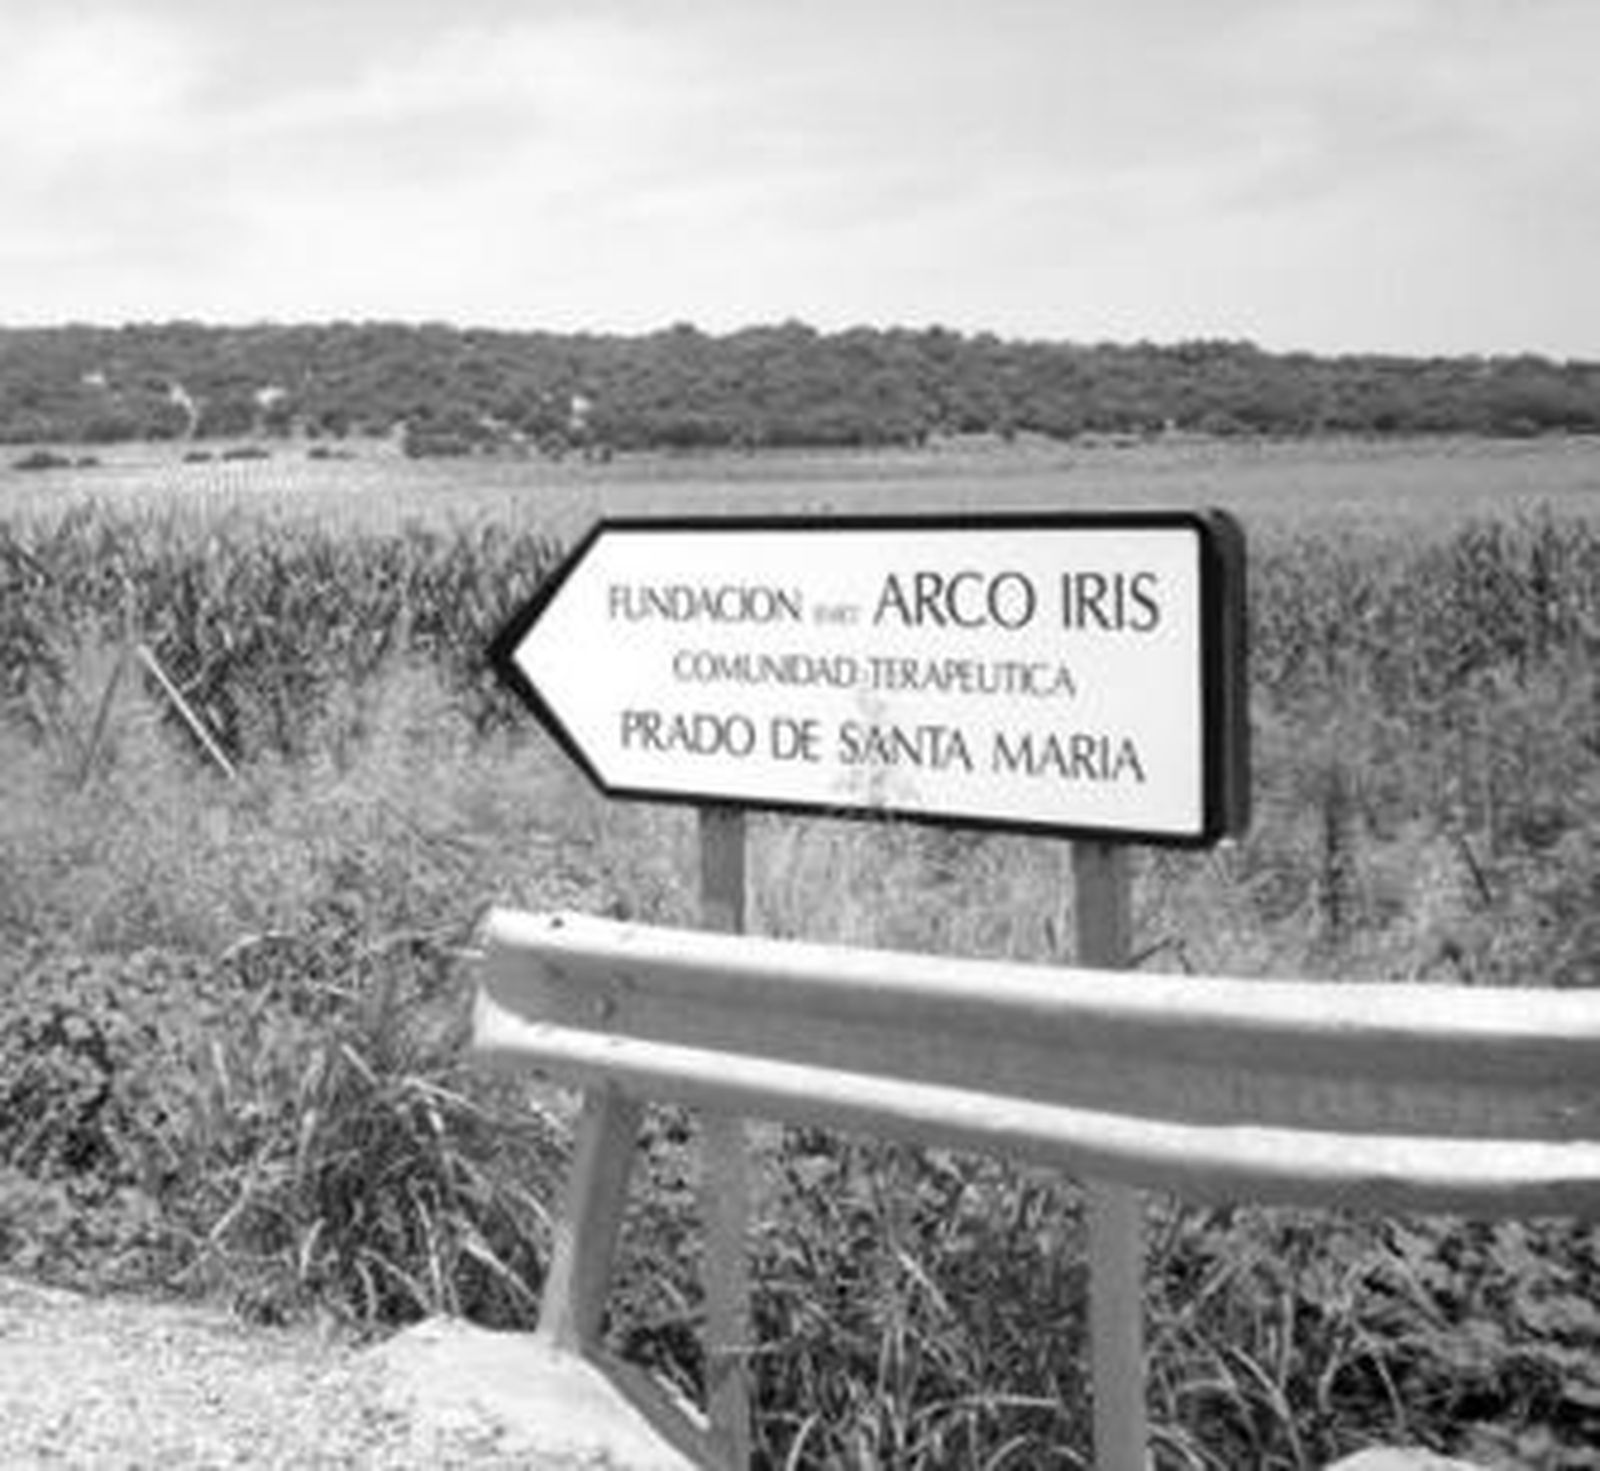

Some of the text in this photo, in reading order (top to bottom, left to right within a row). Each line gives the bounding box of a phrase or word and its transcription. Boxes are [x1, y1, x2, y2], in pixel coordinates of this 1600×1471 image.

[608, 585, 803, 622] FUNDACION
[872, 571, 1038, 631] ARCO
[1061, 571, 1161, 633] IRIS
[672, 650, 1077, 699] COMUNIDAD TERAPEUTICA
[620, 710, 1147, 784] PRADO DE SANTA MARIA
